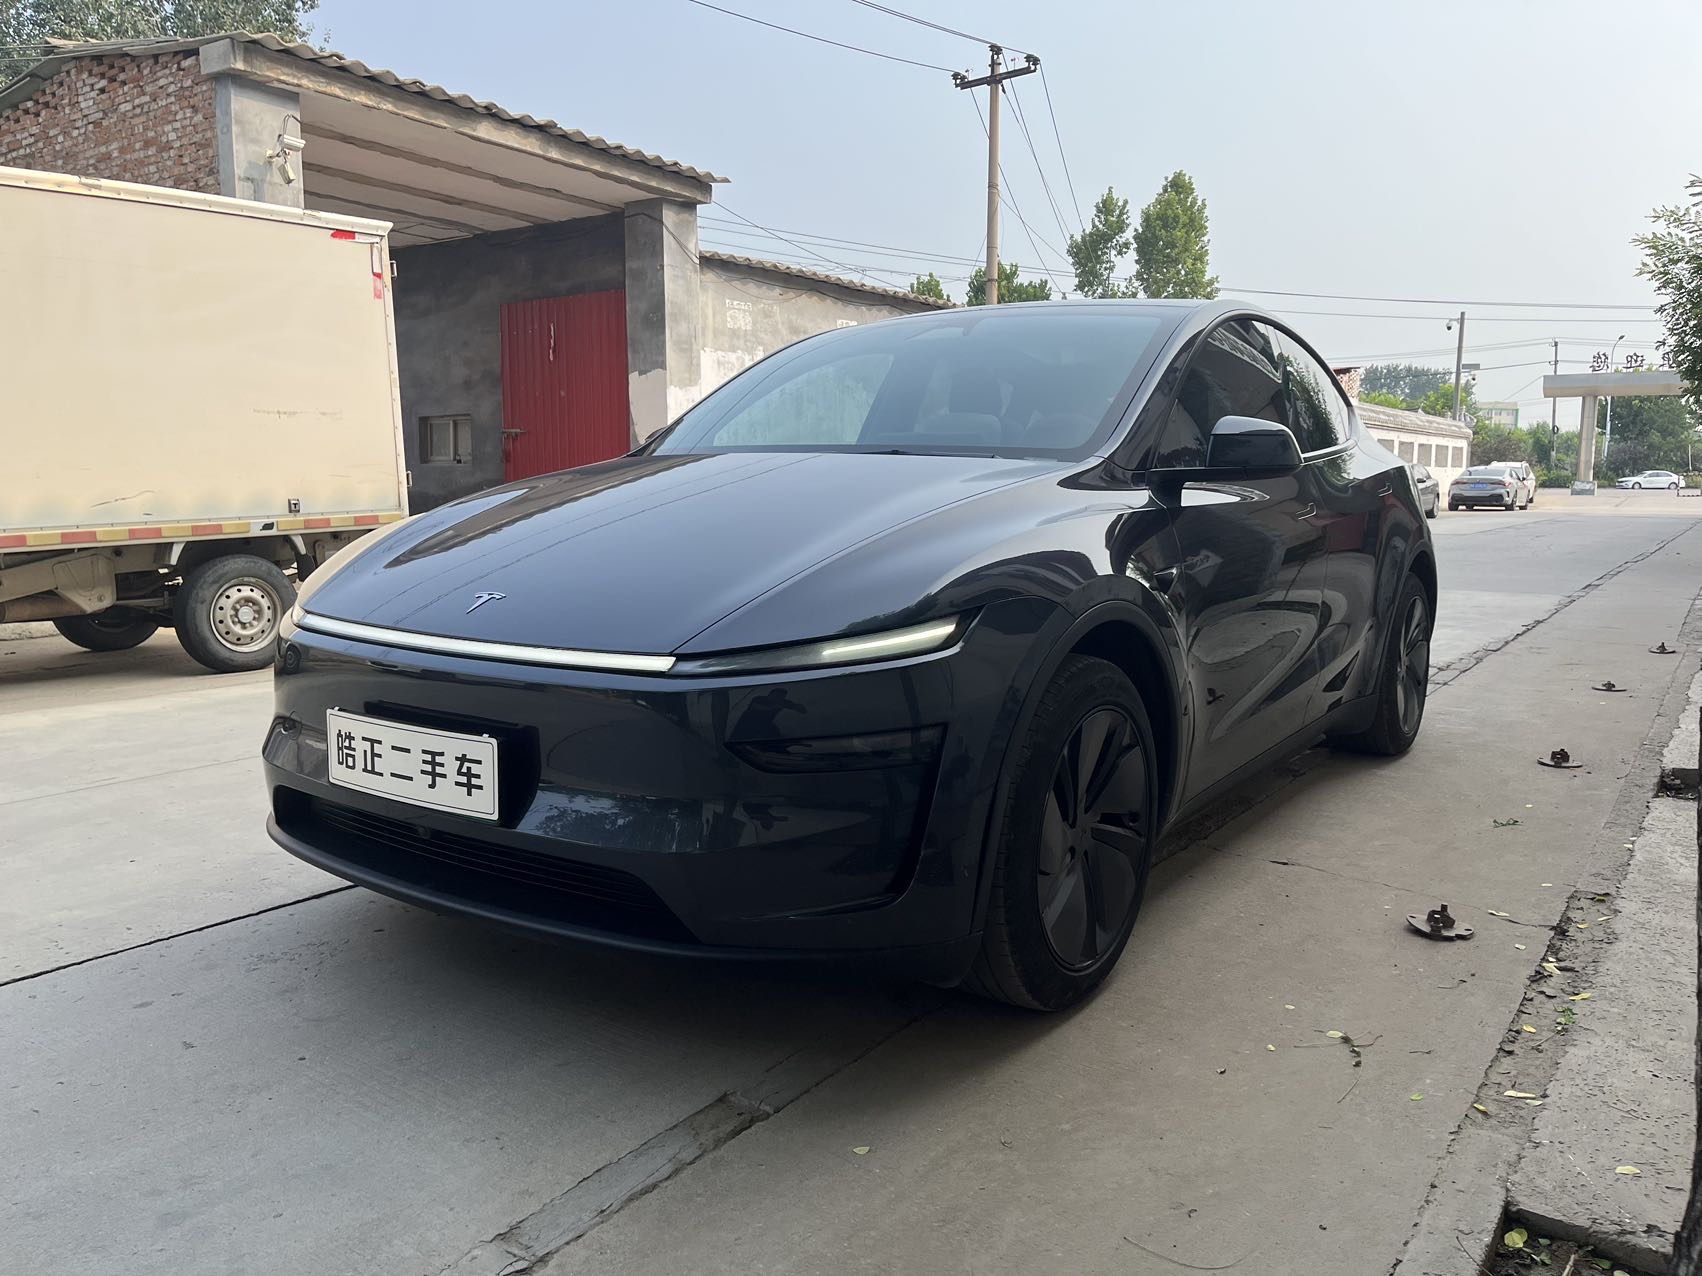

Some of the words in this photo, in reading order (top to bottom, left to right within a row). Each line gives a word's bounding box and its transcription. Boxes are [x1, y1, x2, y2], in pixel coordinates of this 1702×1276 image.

[336, 729, 484, 797] 皓正二手车
